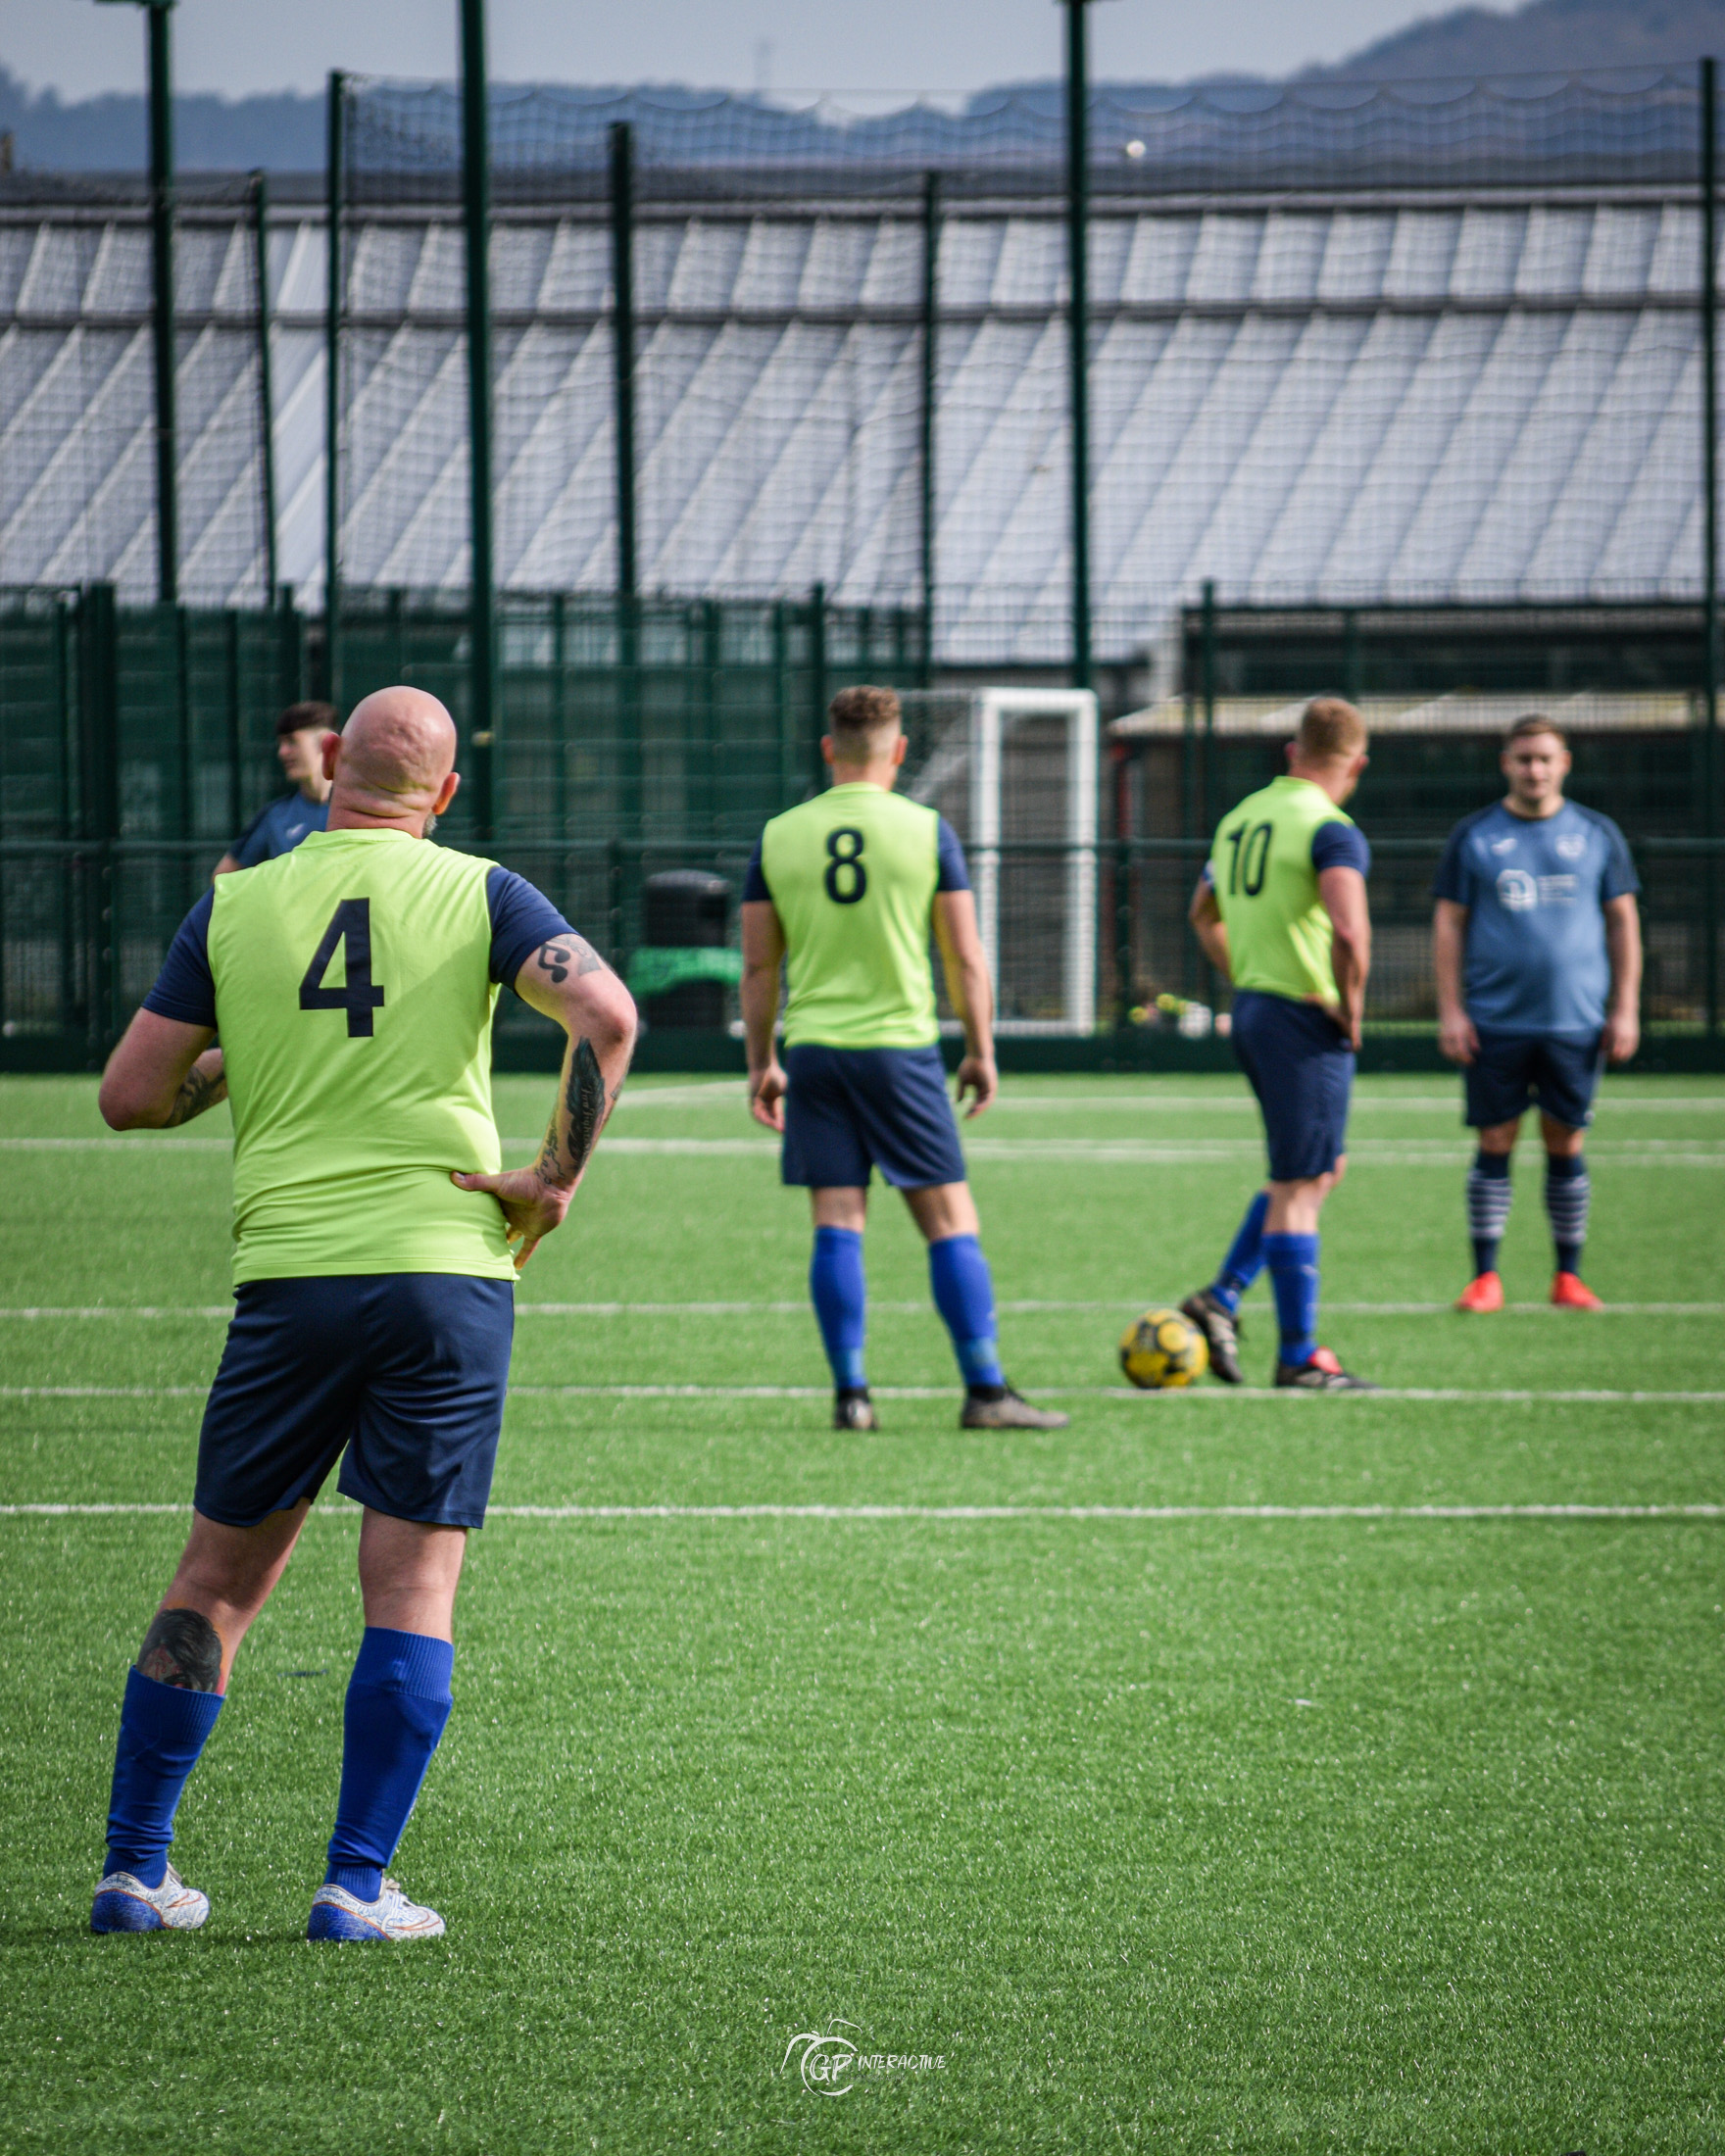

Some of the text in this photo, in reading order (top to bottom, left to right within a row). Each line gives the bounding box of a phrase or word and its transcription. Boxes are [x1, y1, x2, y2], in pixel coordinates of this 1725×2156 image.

[825, 827, 866, 905] 8
[1227, 821, 1272, 896] 10
[299, 897, 384, 1037] 4
